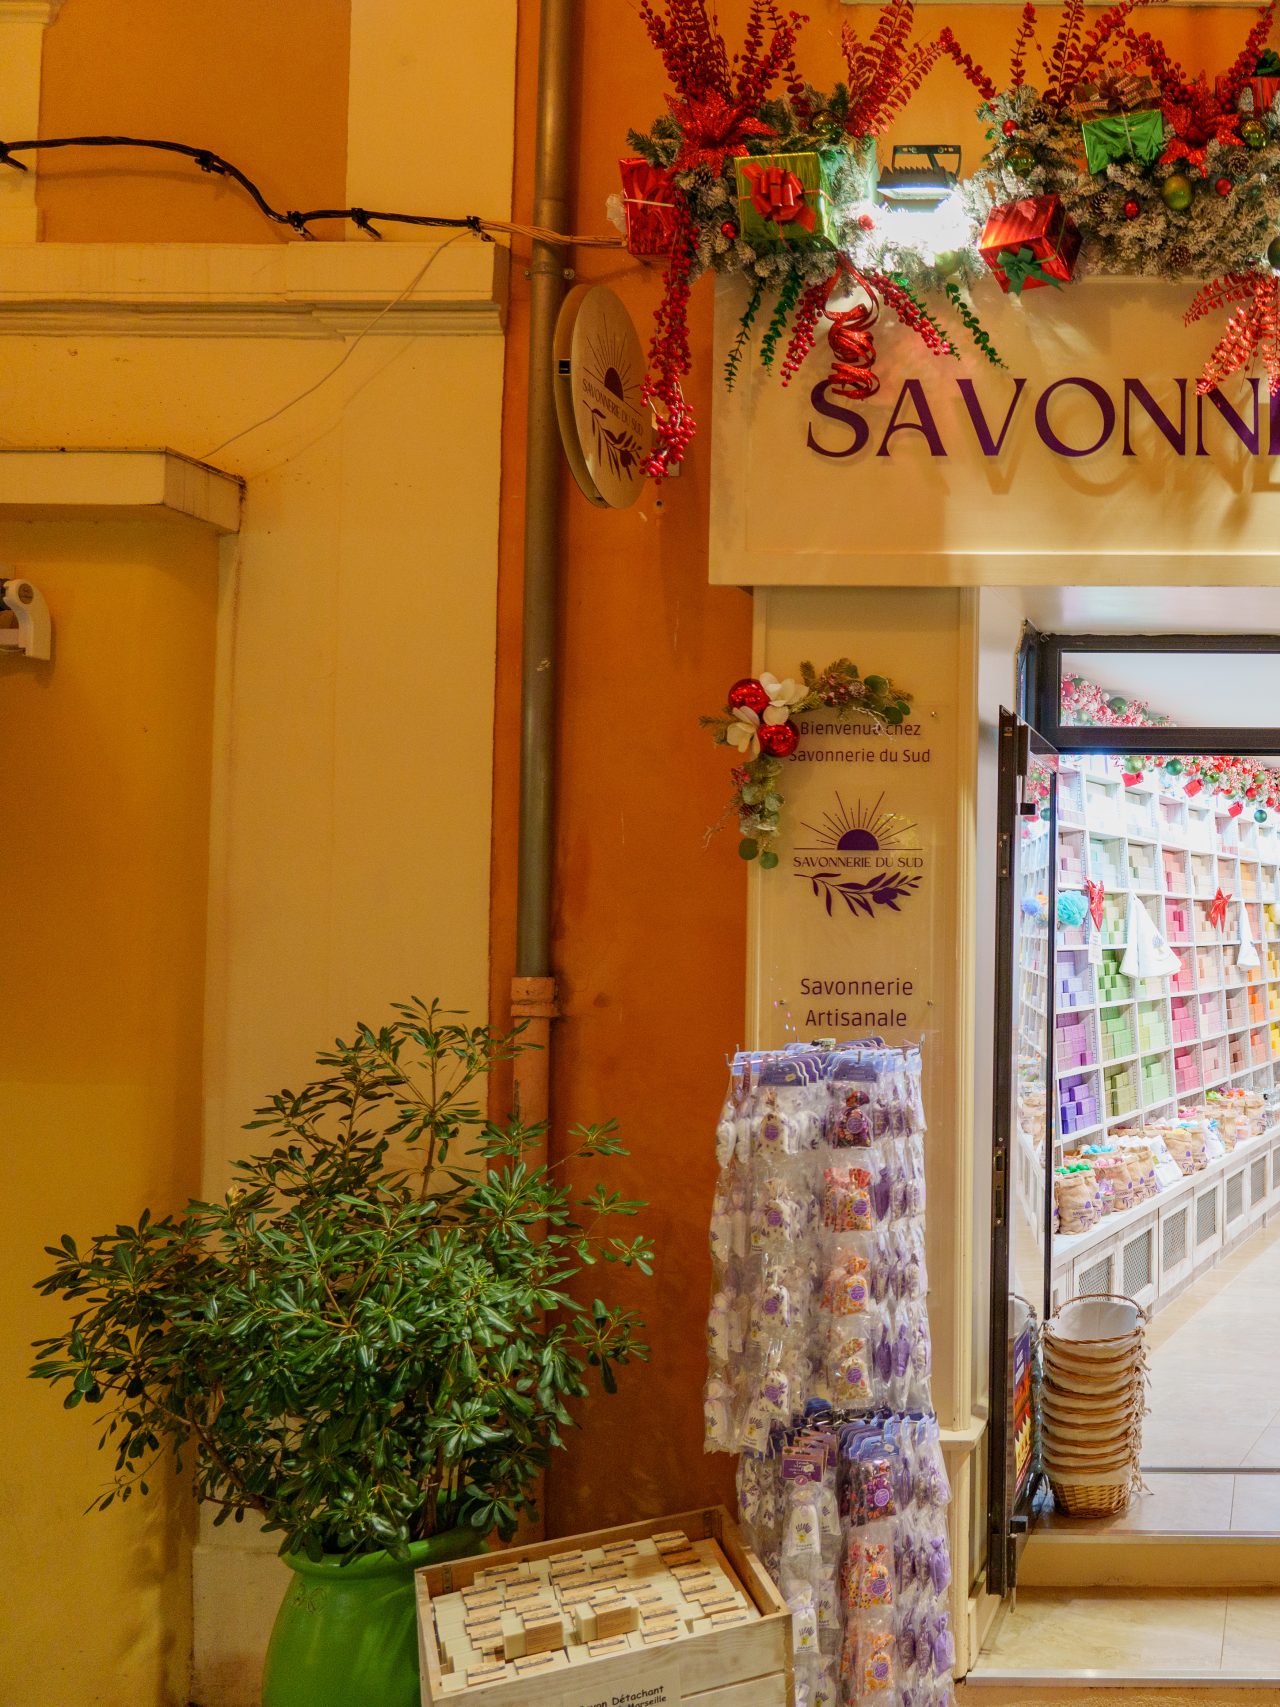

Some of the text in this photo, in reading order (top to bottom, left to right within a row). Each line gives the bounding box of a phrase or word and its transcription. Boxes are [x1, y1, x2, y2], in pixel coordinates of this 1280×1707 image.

[880, 748, 898, 762] du
[903, 748, 931, 763] Sud
[793, 856, 924, 868] SAVONNERIE DU SUD
[800, 977, 914, 996] Savonnerie
[805, 1008, 908, 1027] Artisanale
[612, 1685, 664, 1706] Détachant
